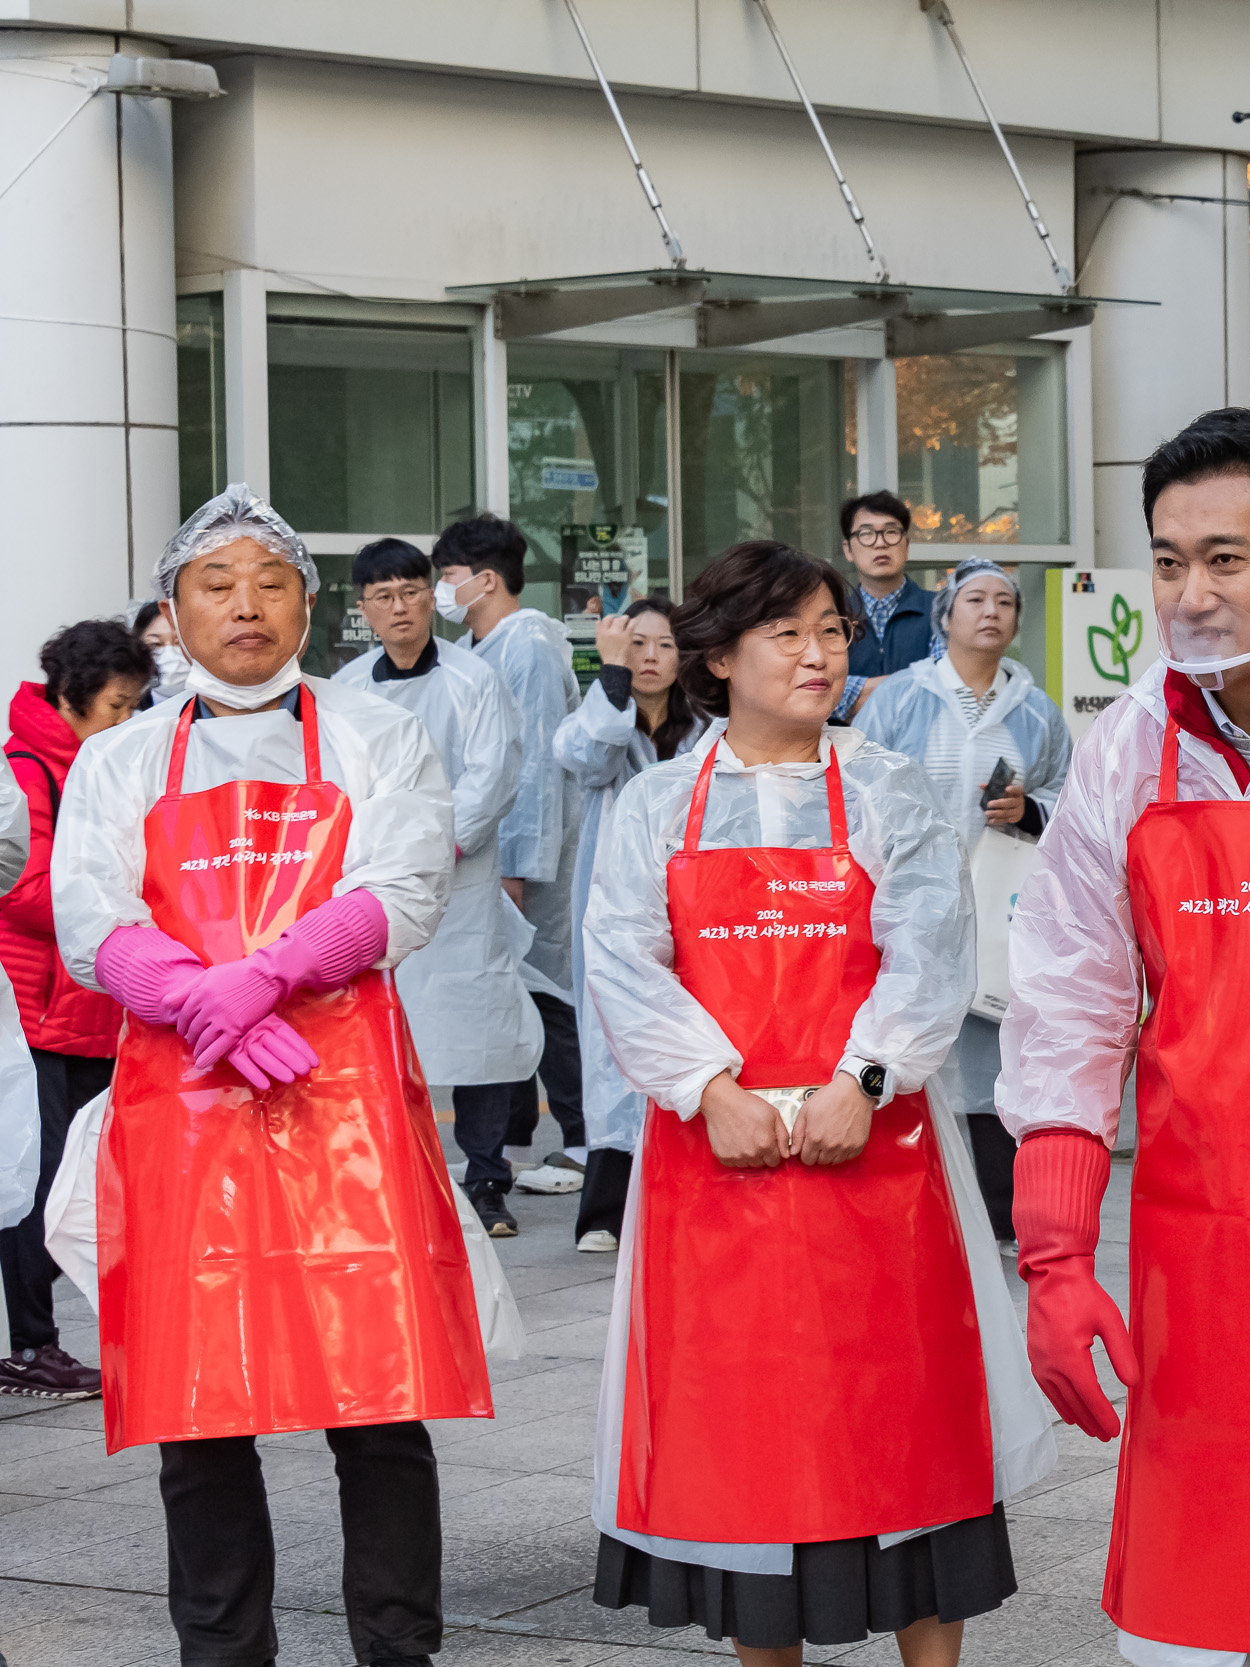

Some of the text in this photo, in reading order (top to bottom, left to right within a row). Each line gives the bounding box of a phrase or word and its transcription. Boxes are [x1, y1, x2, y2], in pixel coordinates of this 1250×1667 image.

[263, 810, 317, 822] KB국민은행
[229, 837, 253, 848] 2024
[179, 849, 313, 871] 제2회 광진 사랑의 김장축제
[788, 880, 846, 891] KB국민은행
[1178, 898, 1214, 915] 제2회
[1216, 898, 1240, 916] 광진
[756, 909, 784, 920] 2024
[698, 921, 847, 939] 제2회 광진 사랑의 김장축제
